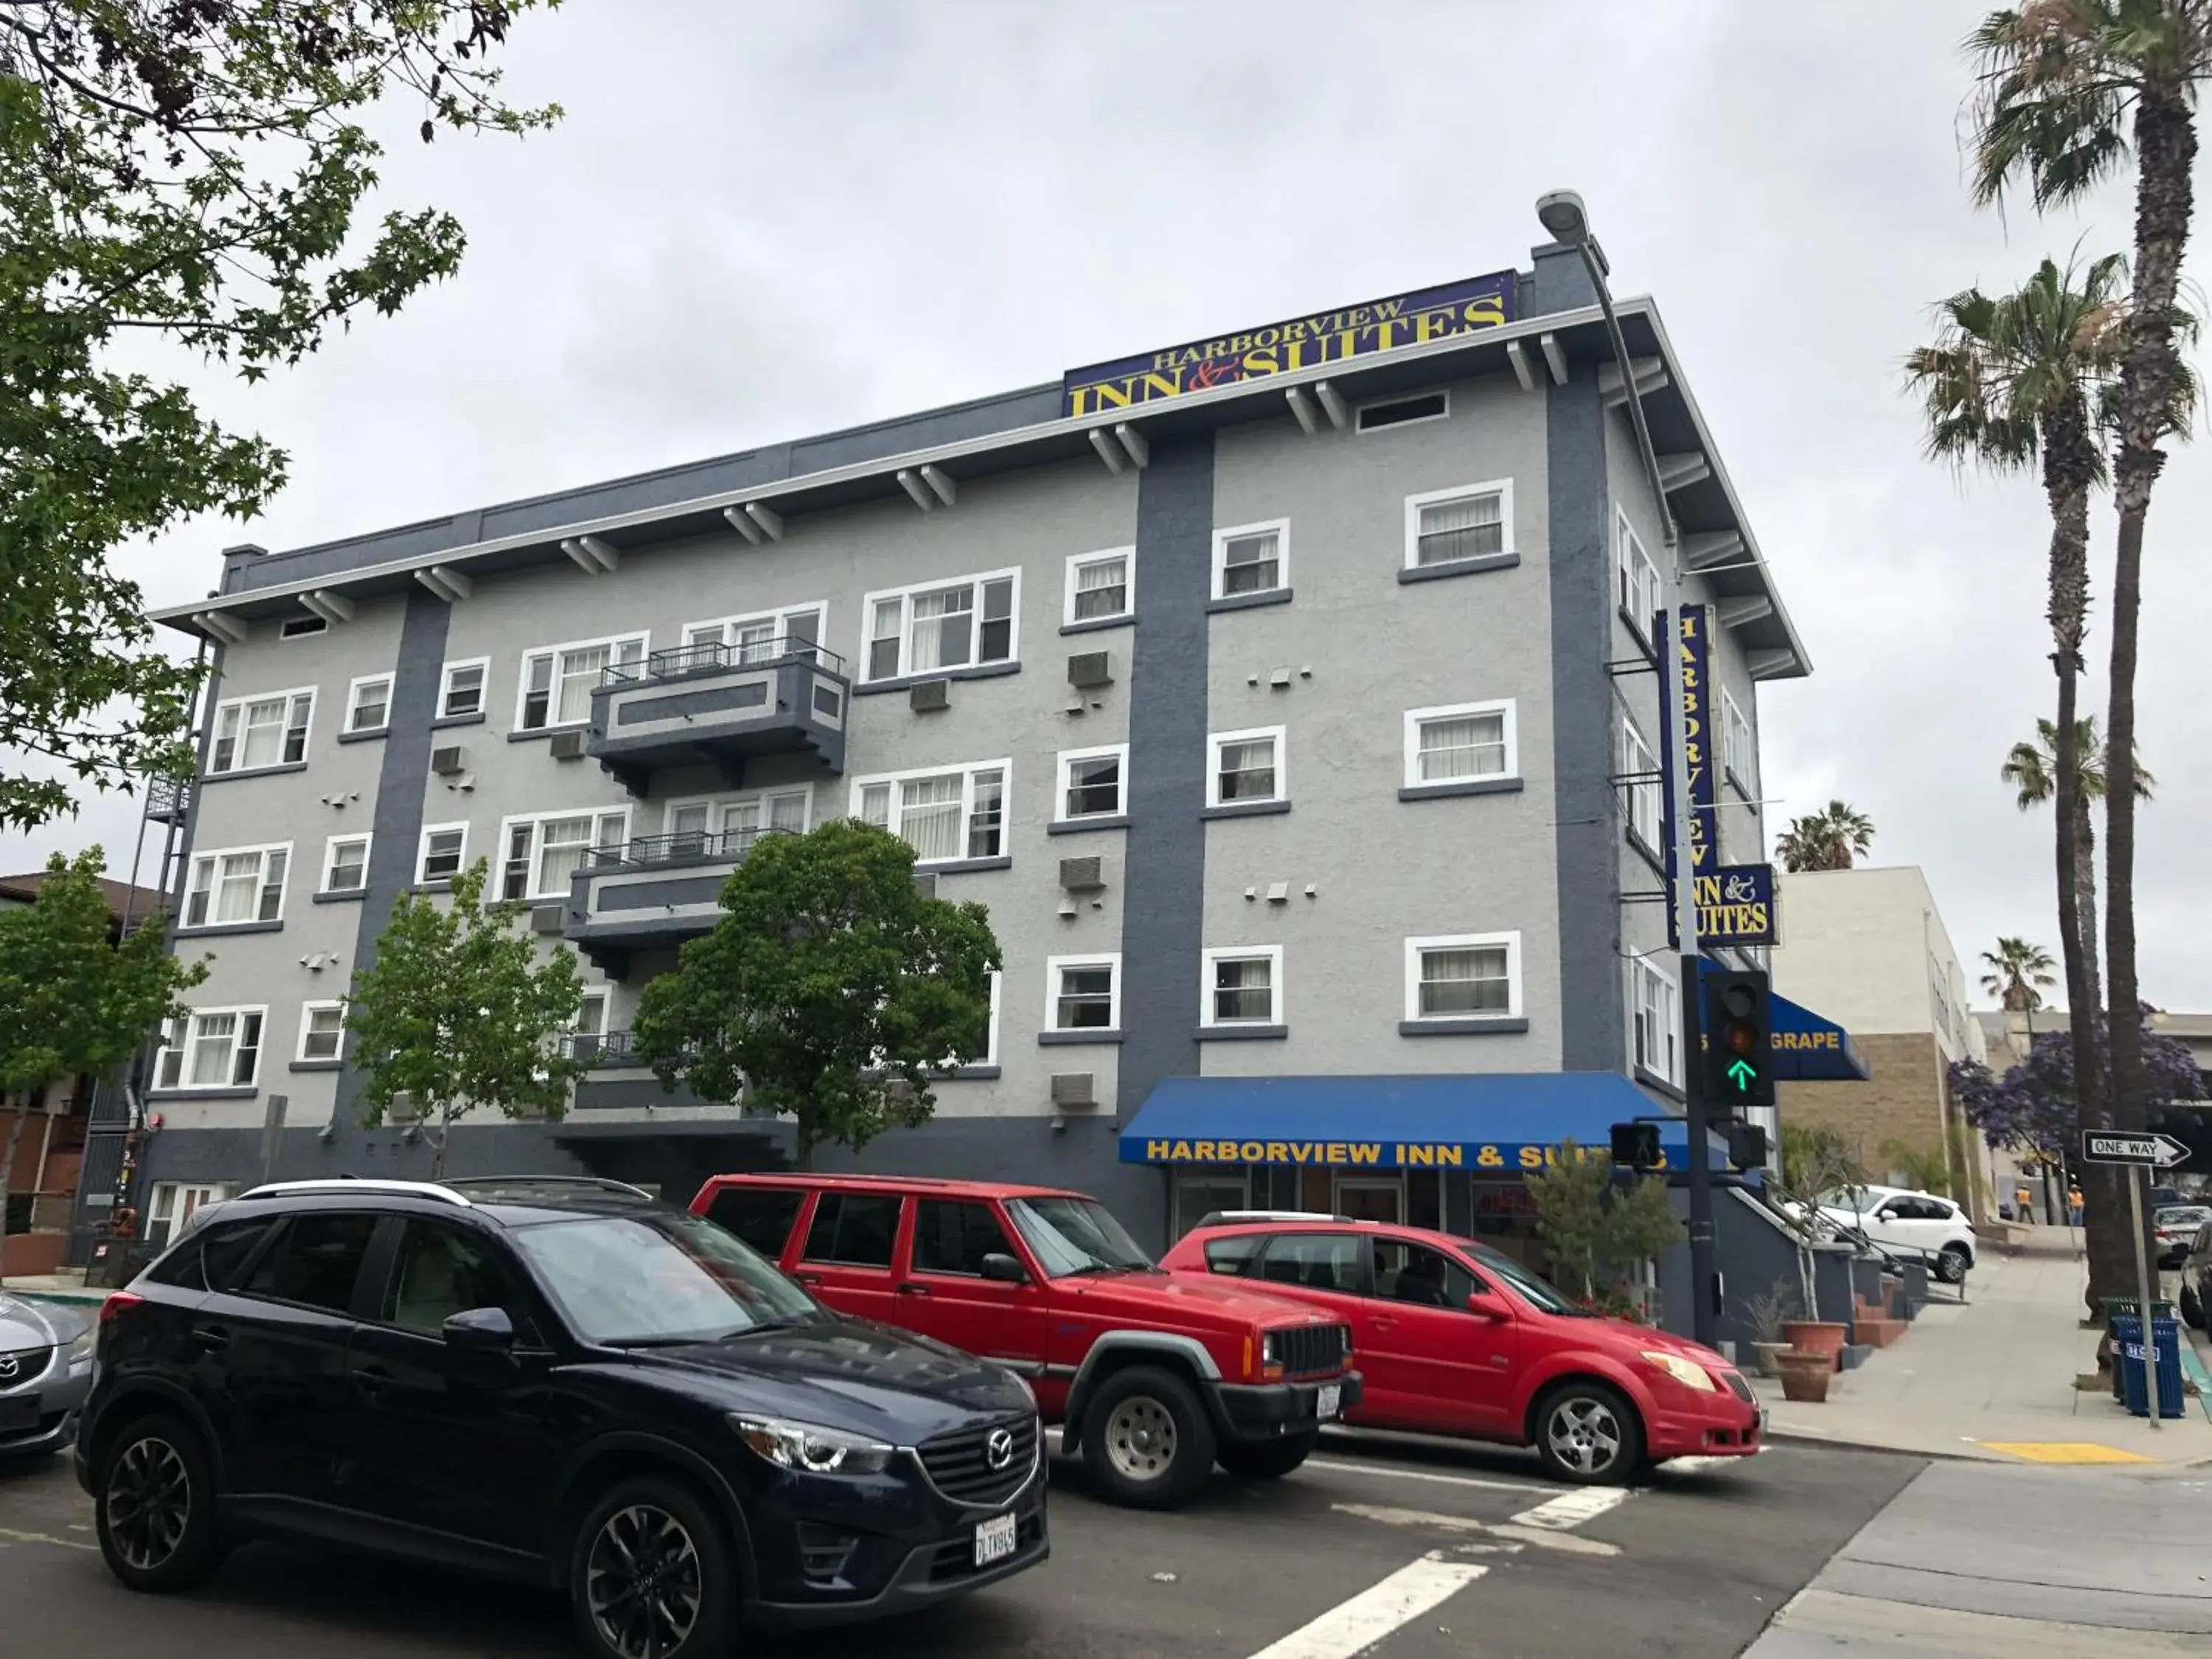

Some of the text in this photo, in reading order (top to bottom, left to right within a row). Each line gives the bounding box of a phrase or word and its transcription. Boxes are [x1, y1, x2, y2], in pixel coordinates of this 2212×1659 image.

[1154, 298, 1405, 369] HARBORVIEW
[1068, 295, 1506, 419] INN & SUITES
[1725, 874, 1756, 902] &
[1770, 1032, 1840, 1050] GRAPE
[1147, 1140, 1668, 1171] HARBORVIEW INN & SUITS
[2095, 1141, 2157, 1155] ONE WAY
